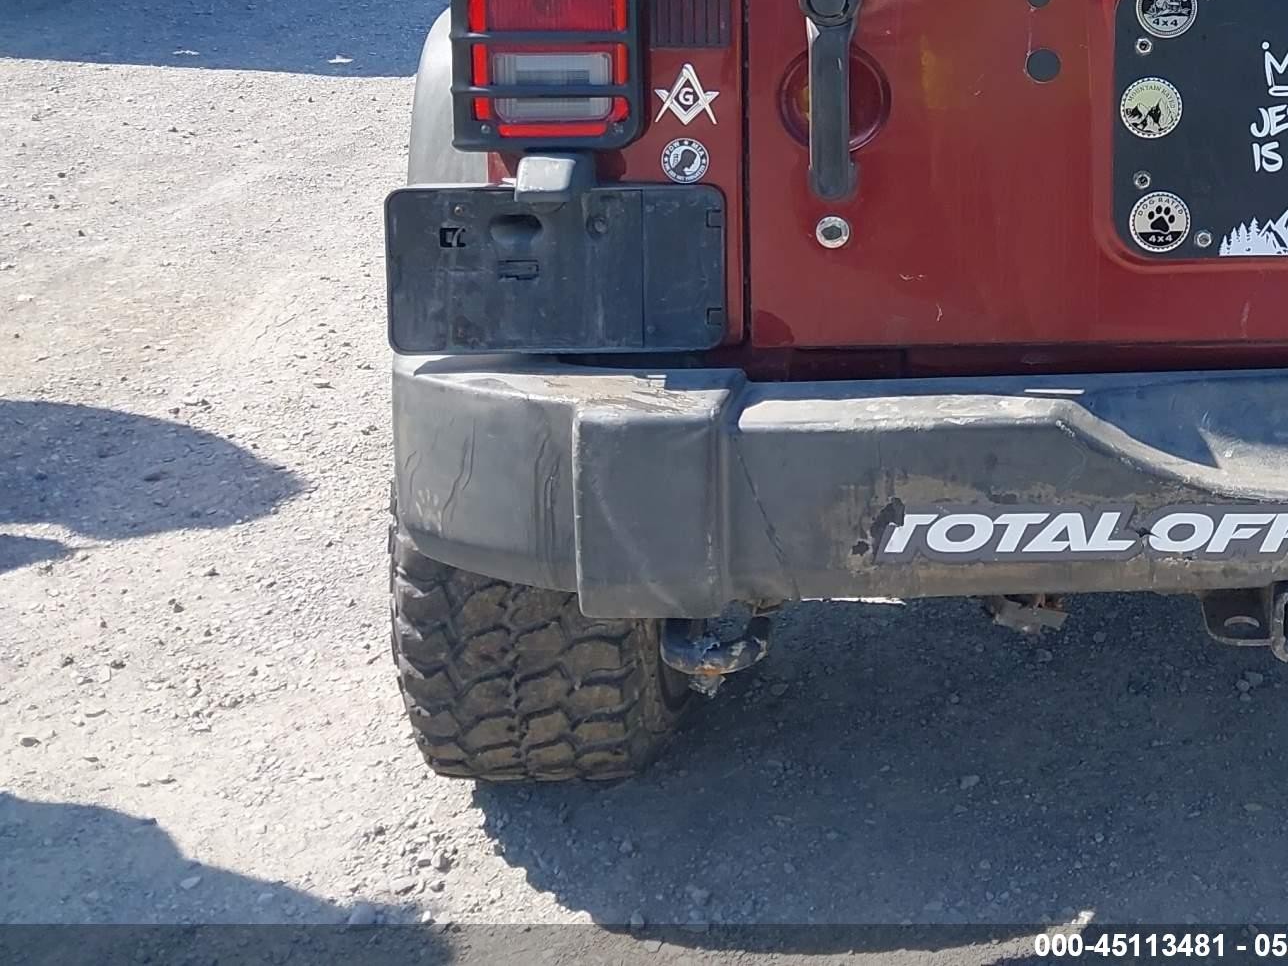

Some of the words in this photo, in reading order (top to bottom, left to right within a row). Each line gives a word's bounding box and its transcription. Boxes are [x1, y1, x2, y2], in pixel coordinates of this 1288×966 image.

[678, 87, 695, 106] G
[1252, 141, 1283, 172] IS
[1137, 199, 1155, 216] DOG
[1158, 197, 1184, 215] RATED
[884, 511, 1137, 553] TOTAL
